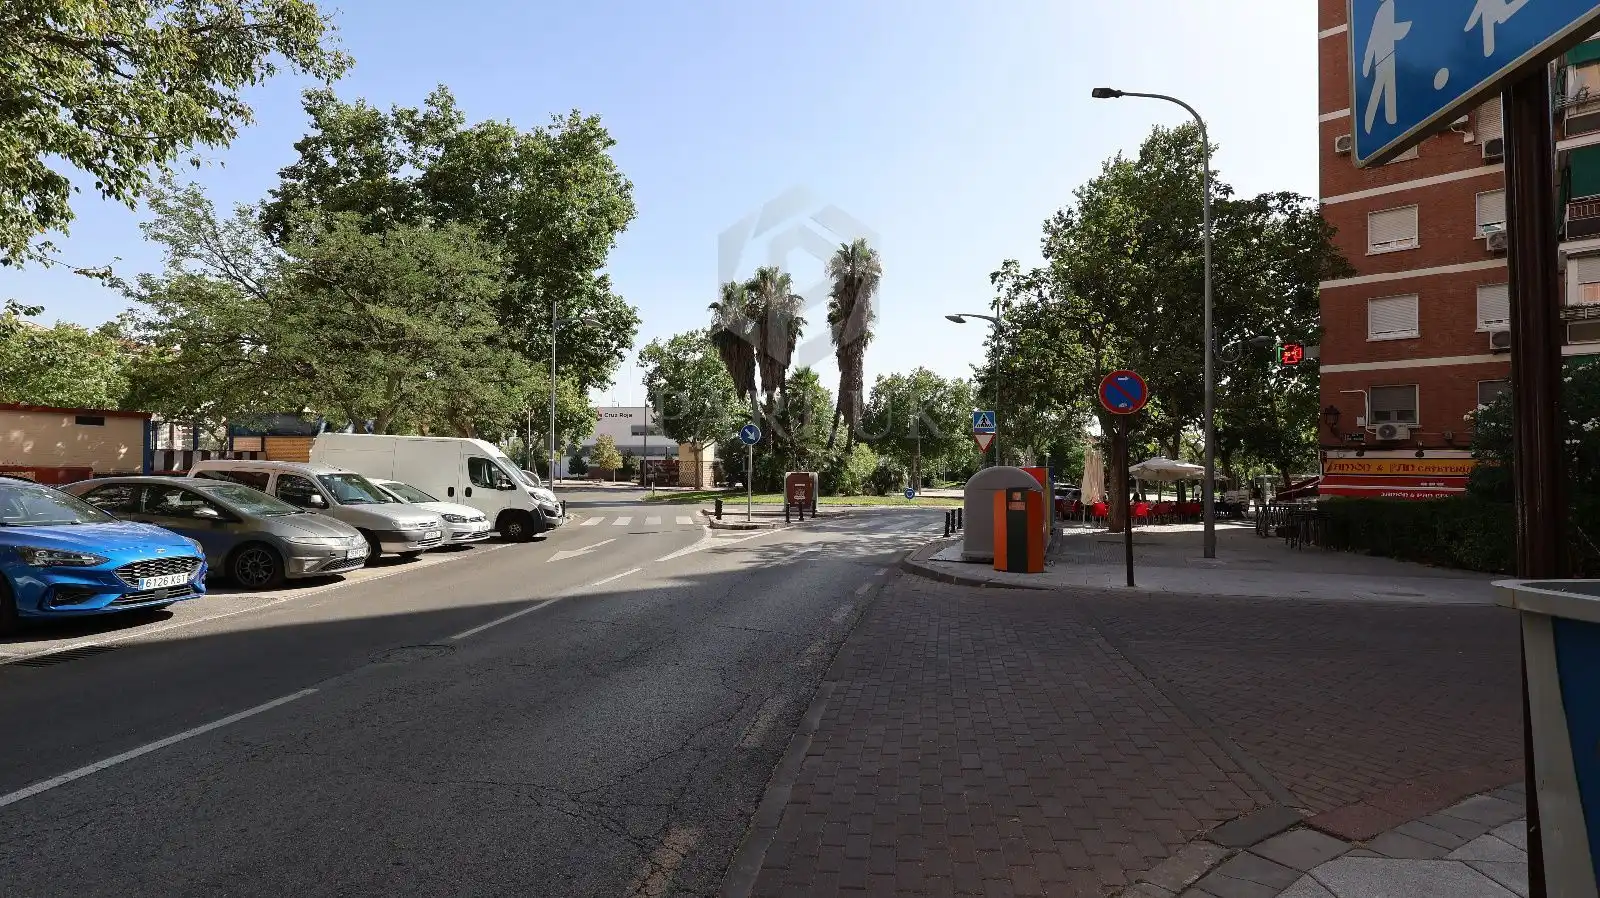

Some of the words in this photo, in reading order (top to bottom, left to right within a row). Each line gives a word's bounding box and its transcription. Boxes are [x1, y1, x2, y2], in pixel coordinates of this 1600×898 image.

[1376, 463, 1385, 472] &
[145, 577, 169, 588] 6126
[170, 574, 186, 585] KST
